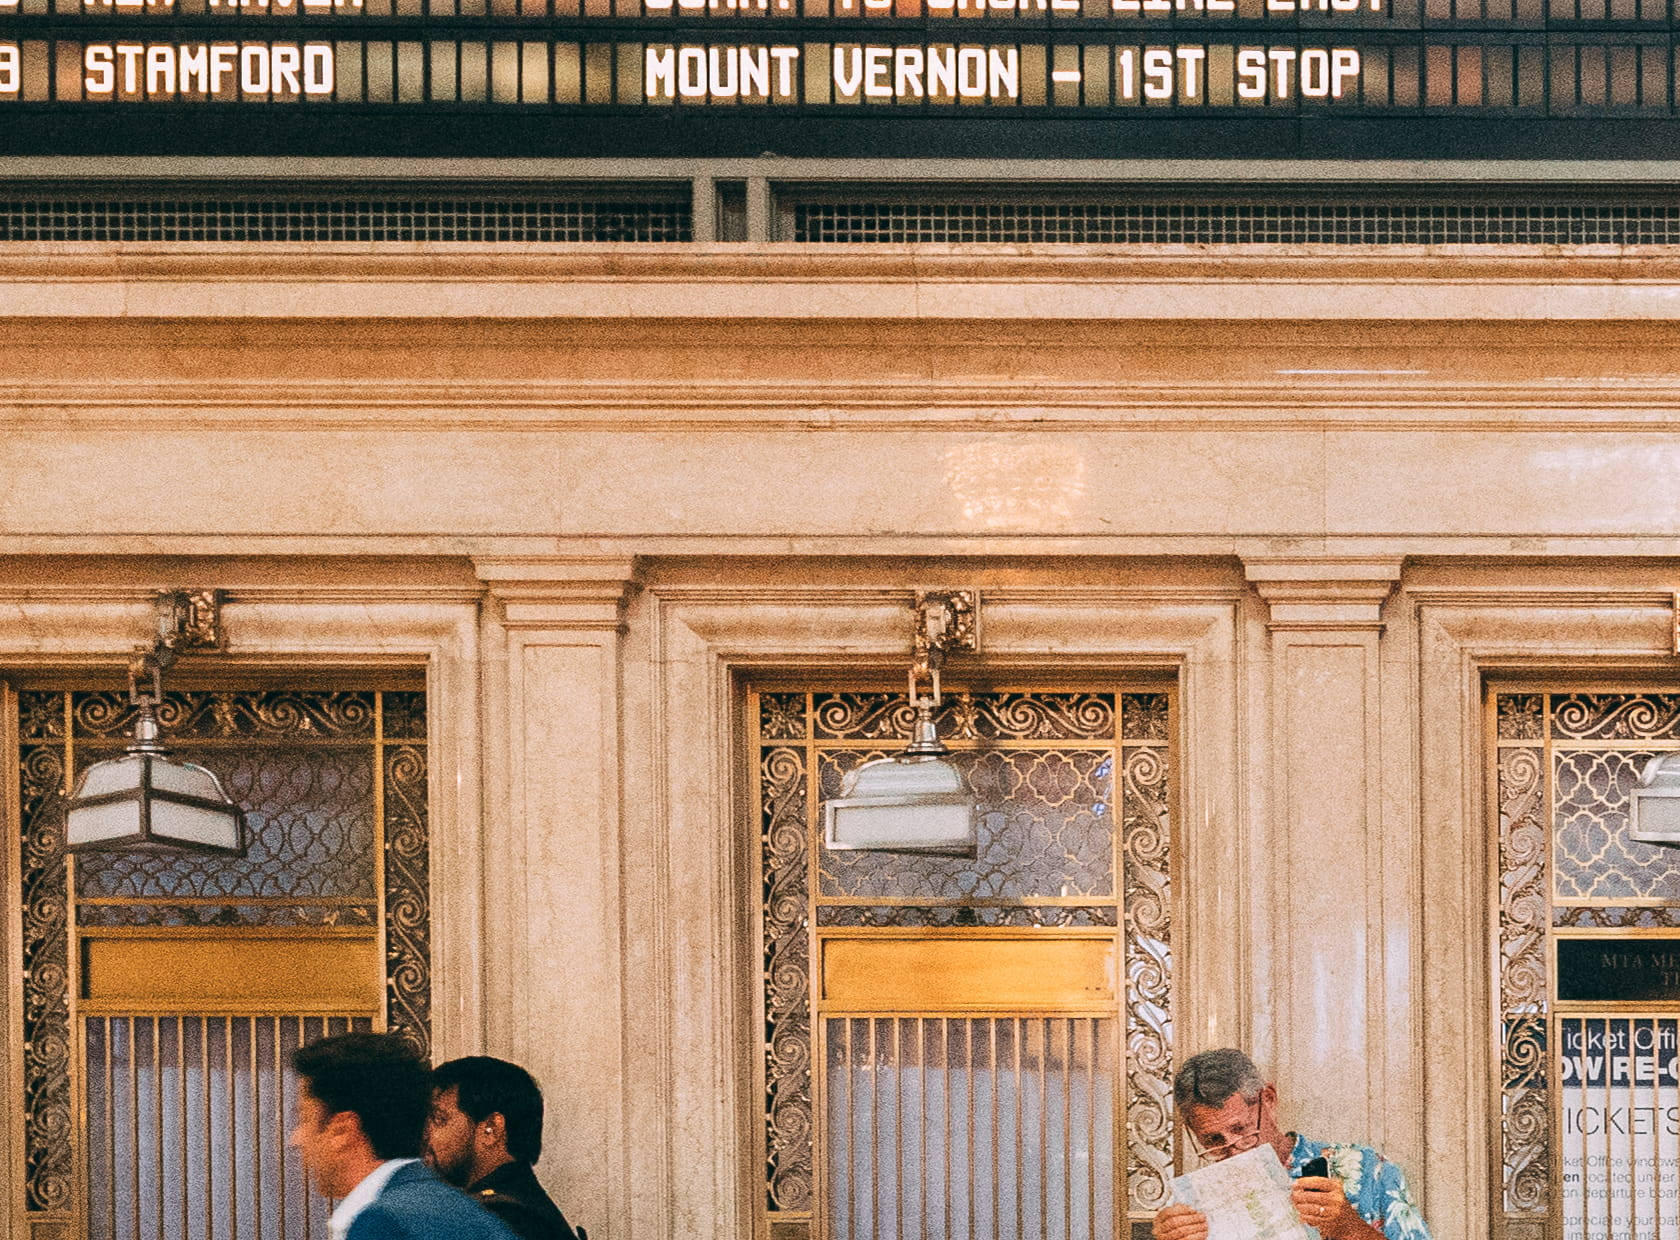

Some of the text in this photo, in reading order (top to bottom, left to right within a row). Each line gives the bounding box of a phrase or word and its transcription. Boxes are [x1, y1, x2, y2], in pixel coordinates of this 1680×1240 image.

[84, 45, 333, 94] STAMFORD
[645, 47, 798, 97] MOUNT
[834, 47, 1017, 98] VERNON
[1119, 48, 1204, 98] 1ST
[1237, 49, 1360, 98] STOP
